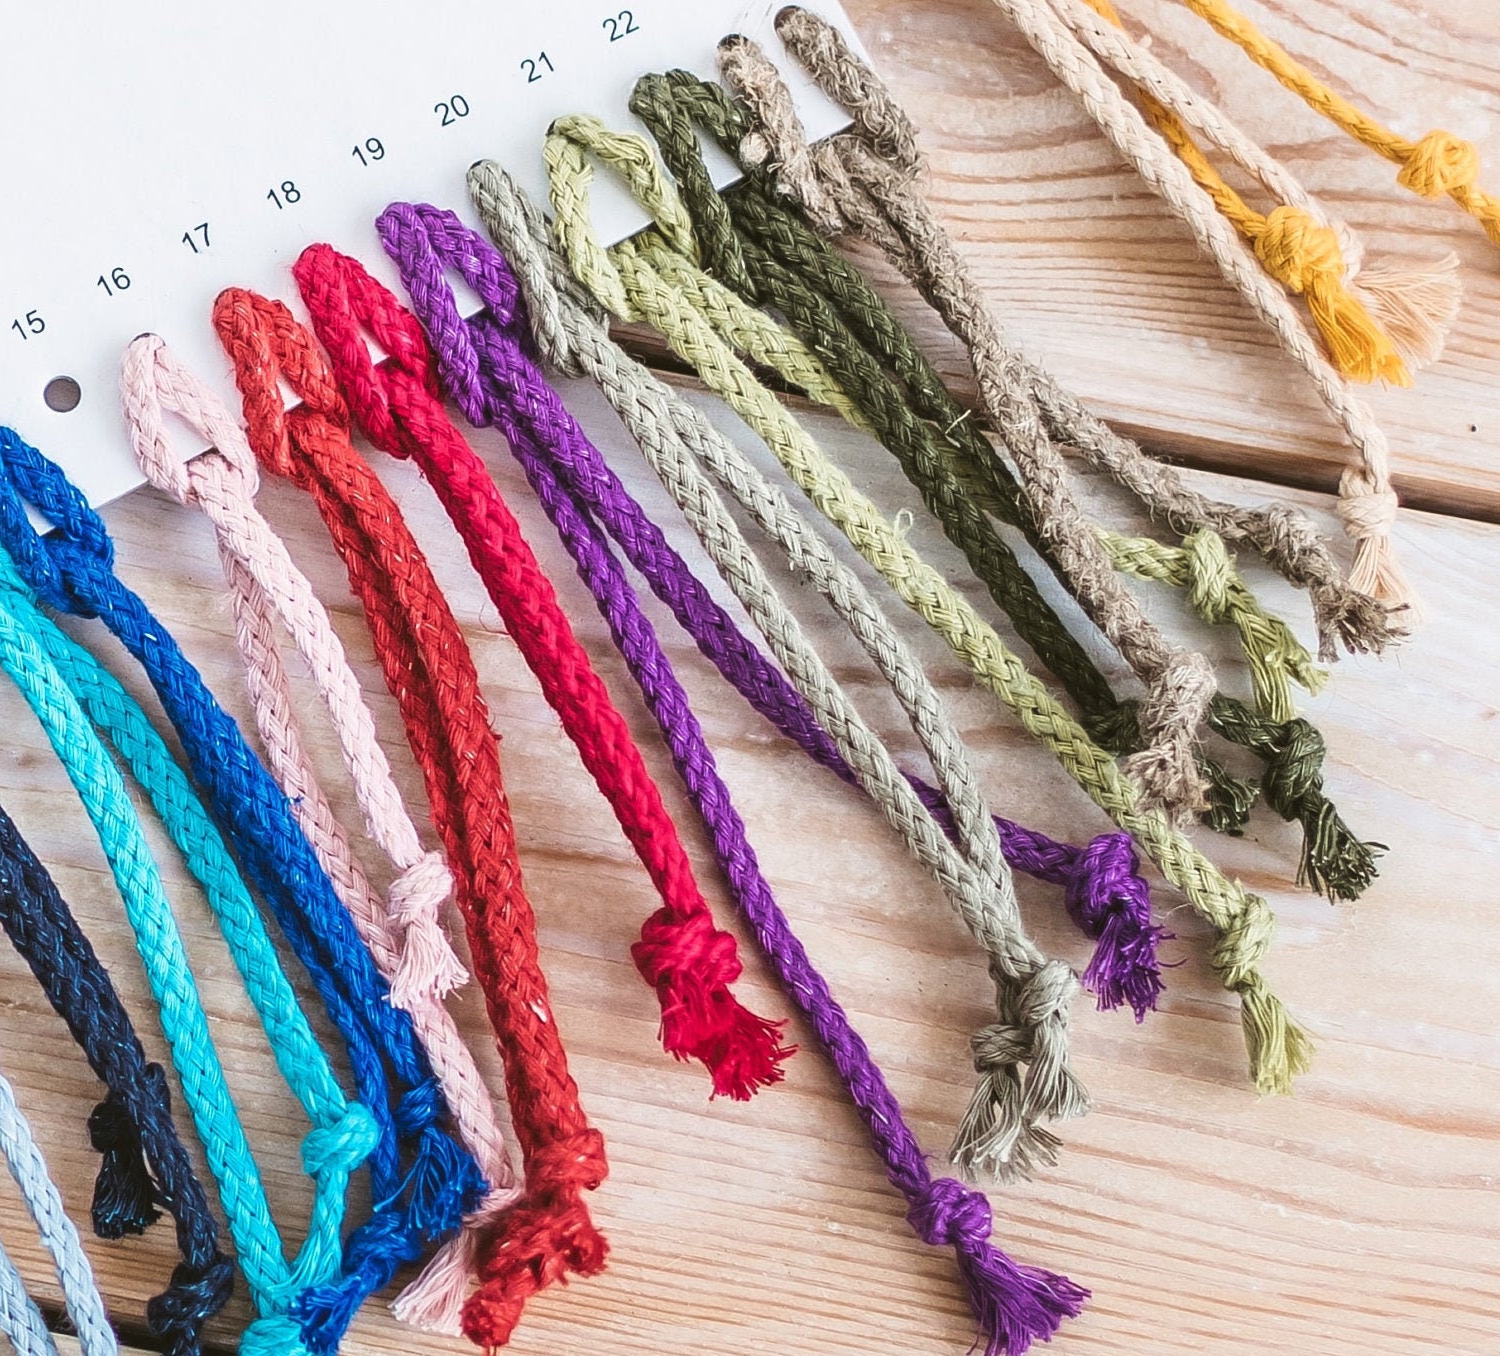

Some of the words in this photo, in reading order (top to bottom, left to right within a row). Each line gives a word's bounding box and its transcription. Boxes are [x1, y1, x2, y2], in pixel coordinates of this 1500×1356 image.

[11, 309, 46, 341] 15
[96, 267, 131, 298] 16
[182, 222, 211, 255] 17
[267, 180, 301, 211] 18
[351, 137, 385, 168] 19
[434, 94, 470, 127] 20
[520, 51, 556, 83] 21
[602, 10, 640, 42] 22
